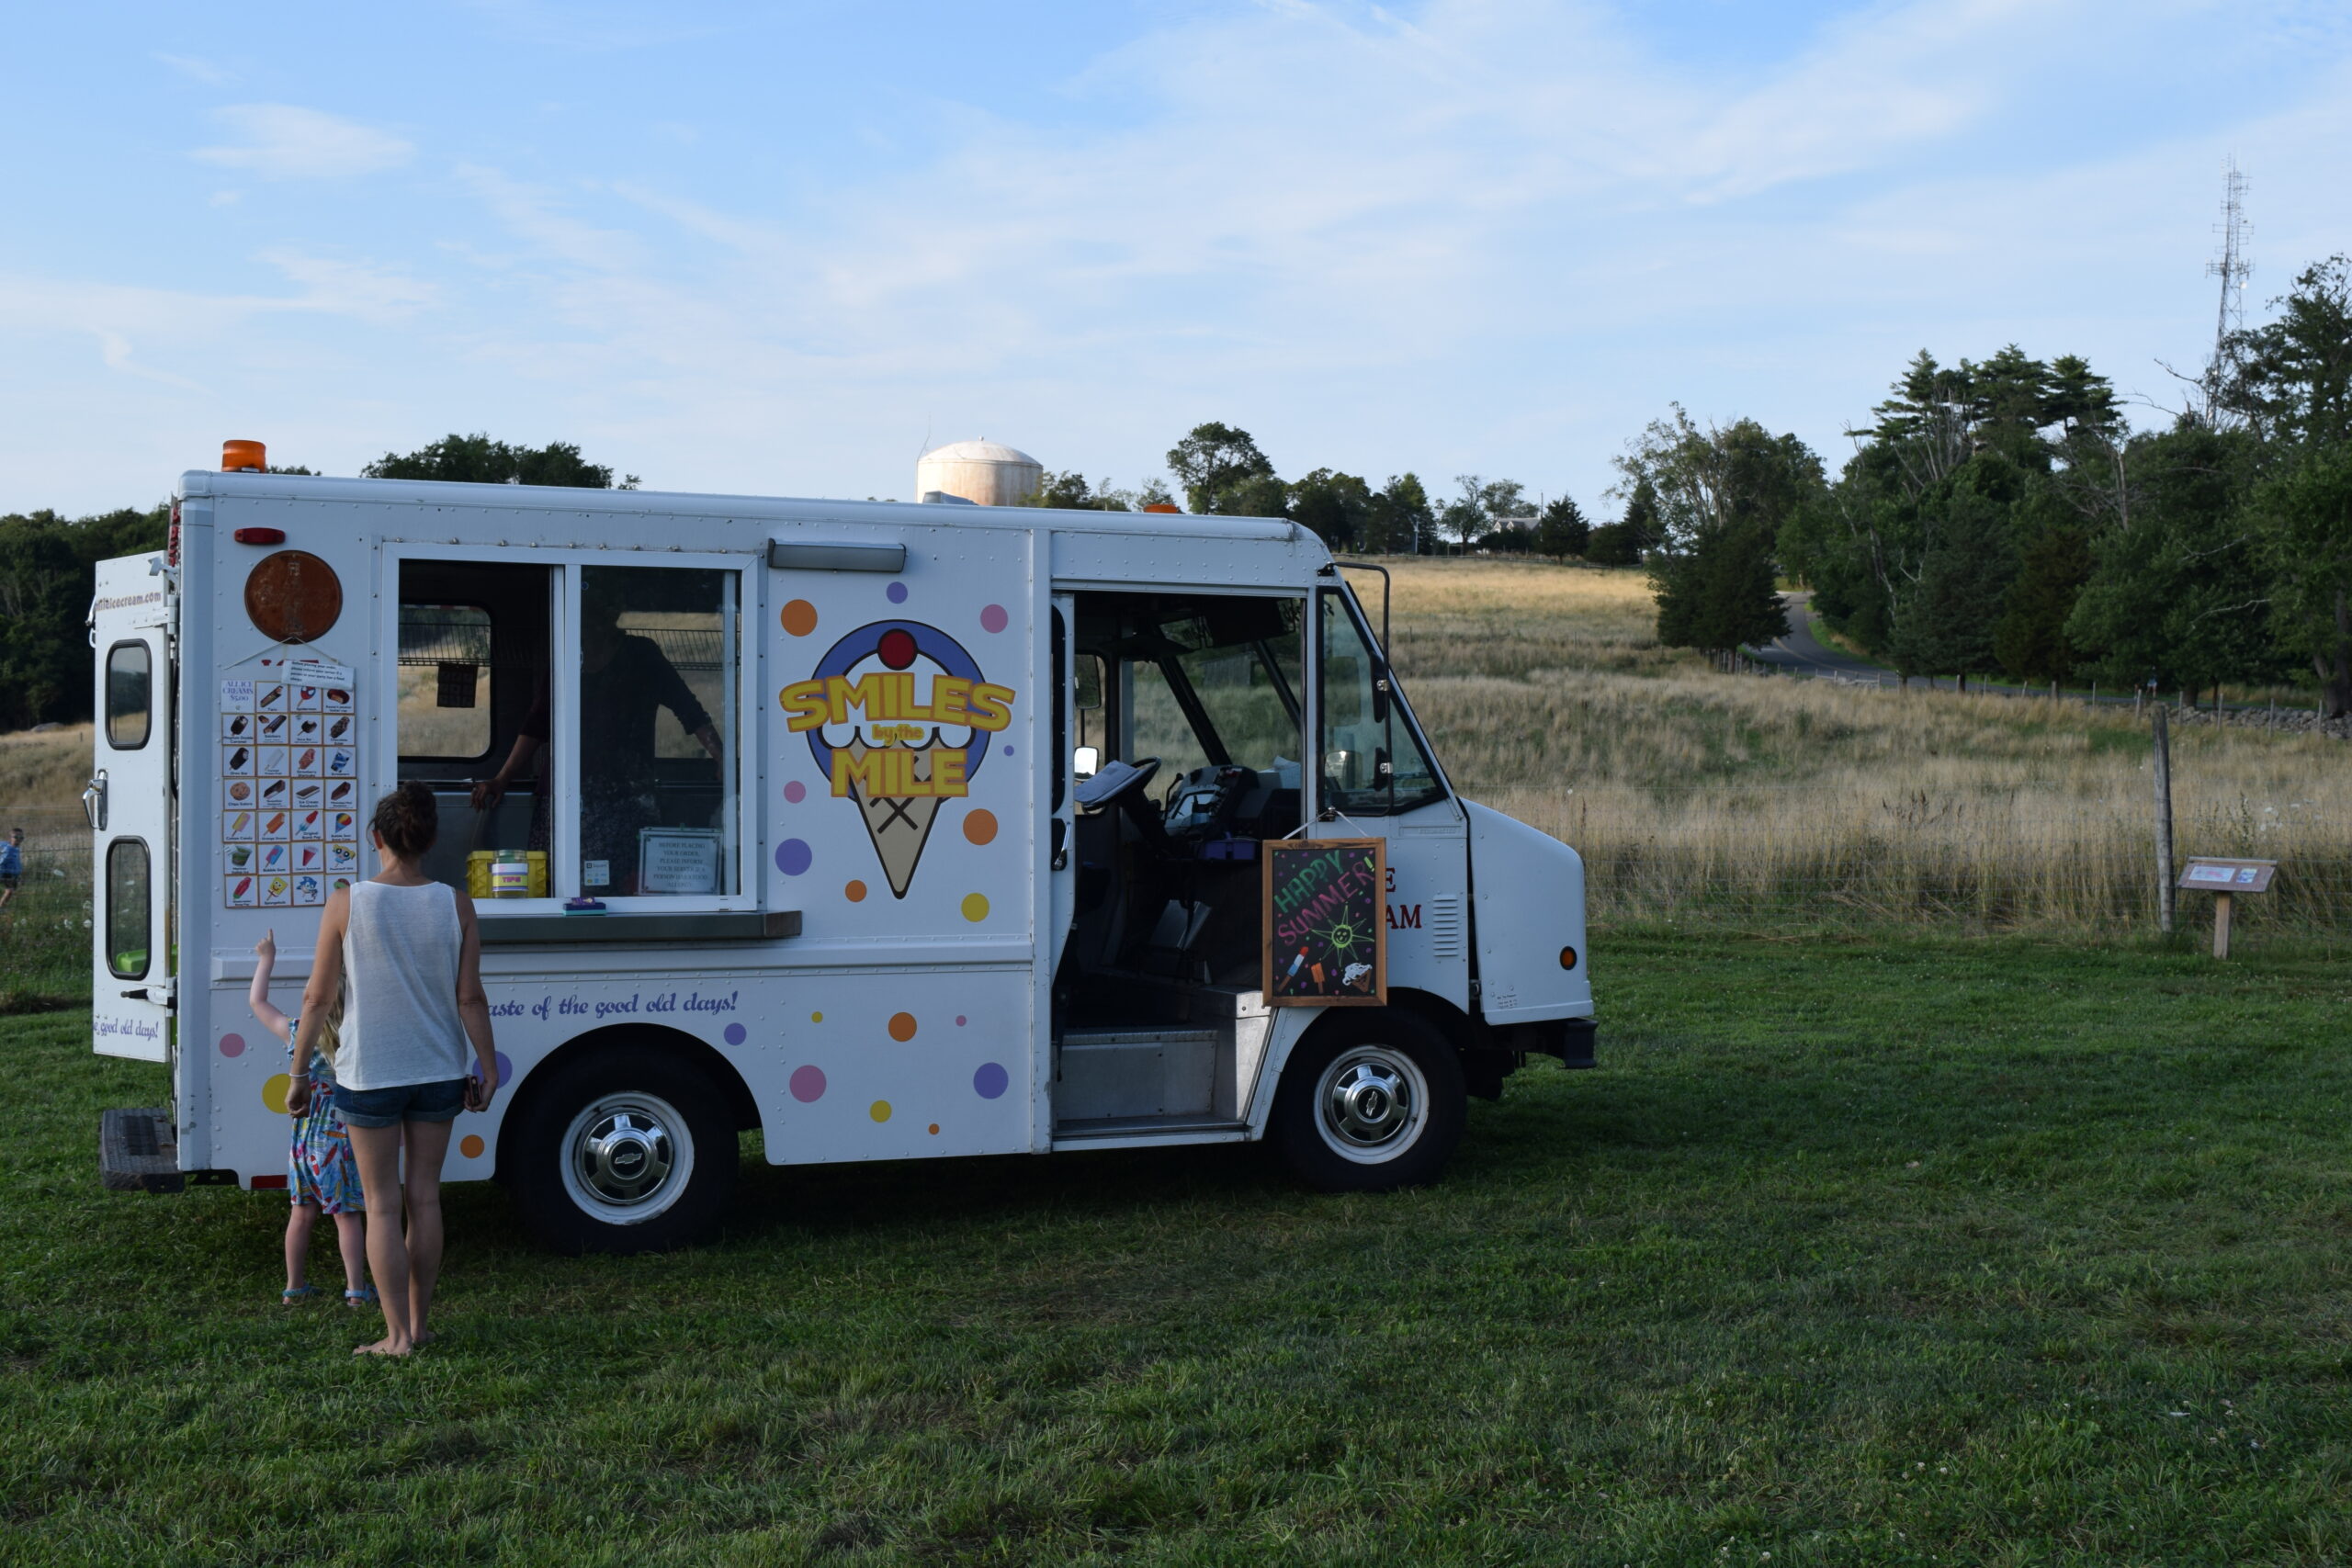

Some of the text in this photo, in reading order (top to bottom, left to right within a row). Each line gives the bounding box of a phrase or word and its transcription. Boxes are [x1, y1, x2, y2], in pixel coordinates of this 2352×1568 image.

[779, 672, 1016, 732] SMILES
[872, 724, 924, 746] by the
[831, 748, 968, 797] MILE
[1273, 850, 1343, 913] HAPPY
[531, 995, 552, 1021] of
[559, 994, 588, 1015] the
[595, 993, 639, 1020] good
[645, 992, 677, 1012] old
[684, 990, 739, 1016] days!
[100, 1018, 118, 1037] good
[120, 1019, 133, 1035] old
[136, 1021, 159, 1042] days!
